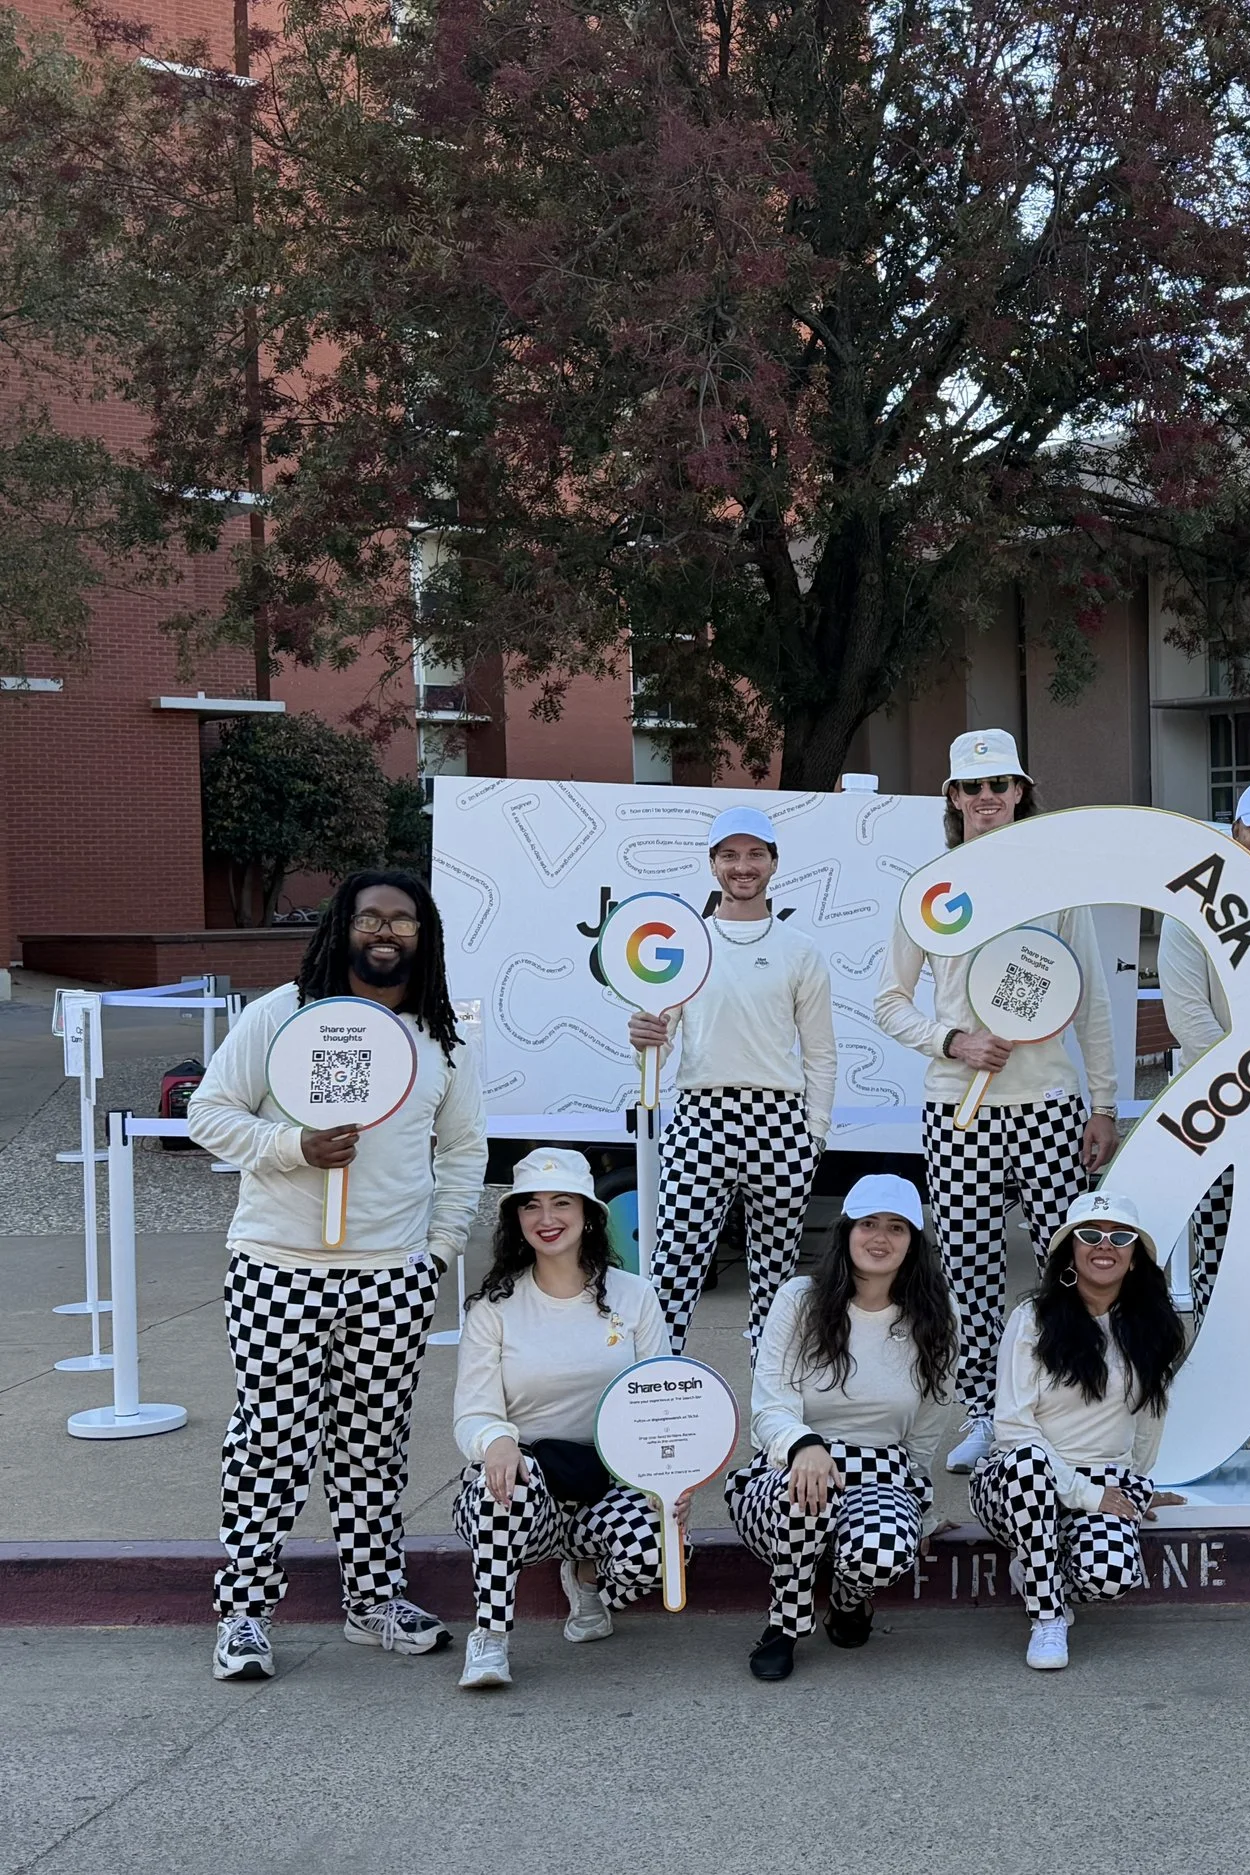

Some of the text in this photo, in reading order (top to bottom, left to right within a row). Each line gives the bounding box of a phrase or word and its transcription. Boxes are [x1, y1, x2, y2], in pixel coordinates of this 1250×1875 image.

[975, 743, 989, 755] G
[921, 882, 973, 935] G
[626, 921, 685, 984] G
[1021, 945, 1055, 966] Share your
[1020, 954, 1050, 972] thoughts
[319, 1025, 367, 1035] Share your
[322, 1034, 363, 1043] thoughts
[628, 1377, 702, 1395] Share to spin
[913, 1552, 1018, 1600] FIR
